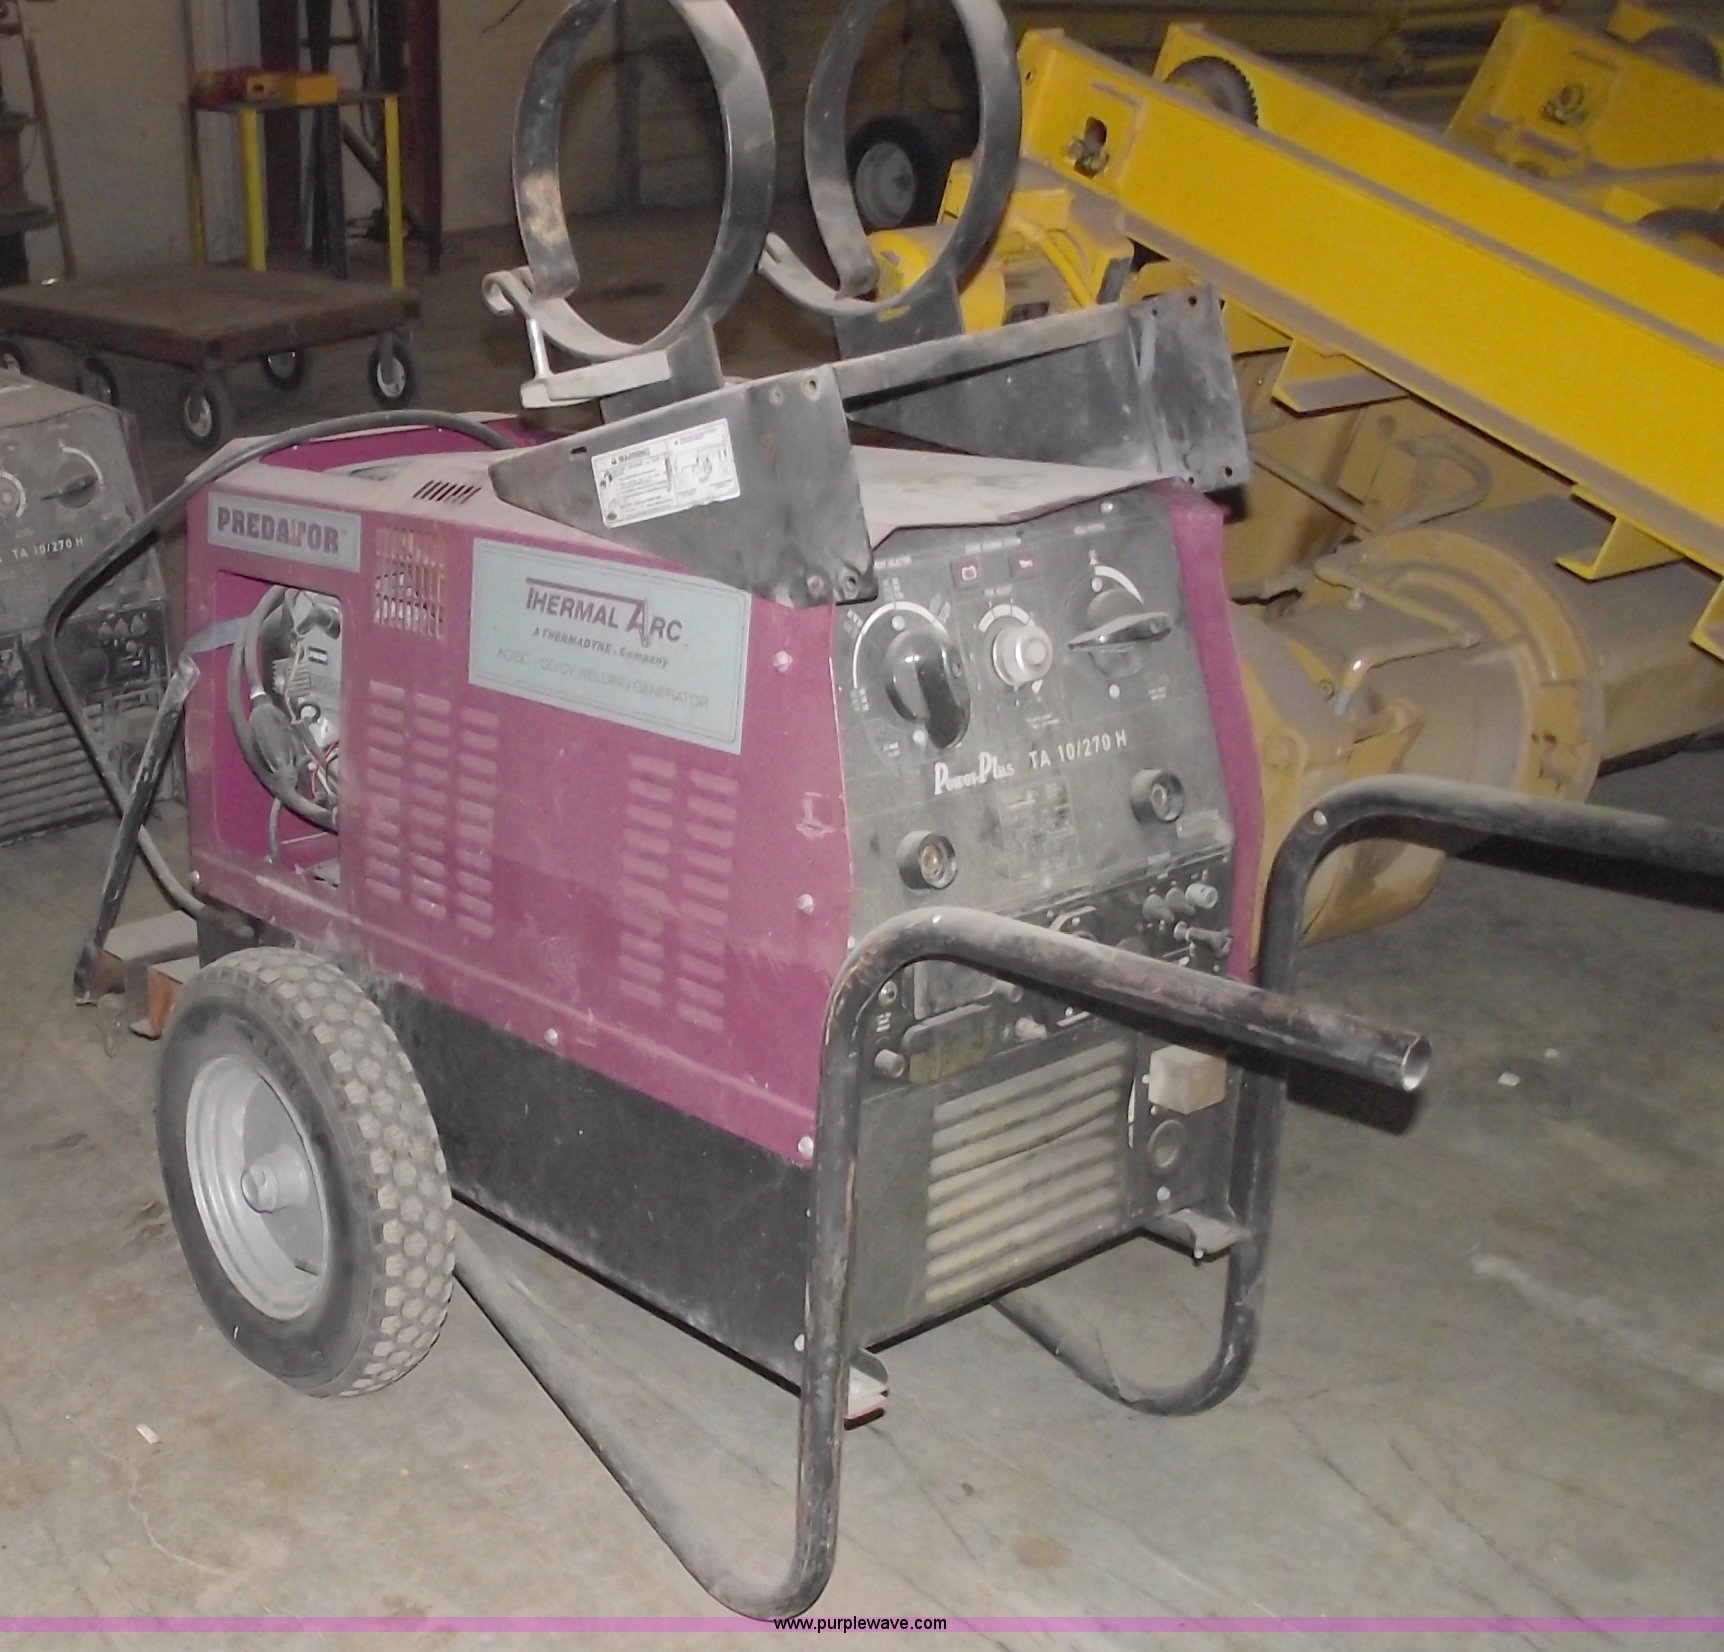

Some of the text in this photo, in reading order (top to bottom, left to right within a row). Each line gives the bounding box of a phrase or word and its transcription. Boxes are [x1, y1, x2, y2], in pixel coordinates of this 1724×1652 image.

[12, 536, 83, 559] TA 10/270 H
[217, 506, 339, 554] PREDATOR
[525, 577, 683, 648] THERMAL ARC
[533, 627, 669, 668] A THERMADYNE Company
[632, 681, 709, 708] GENERATOR
[1029, 750, 1051, 770] TA
[1057, 733, 1111, 762] 10/270
[1115, 729, 1127, 748] H
